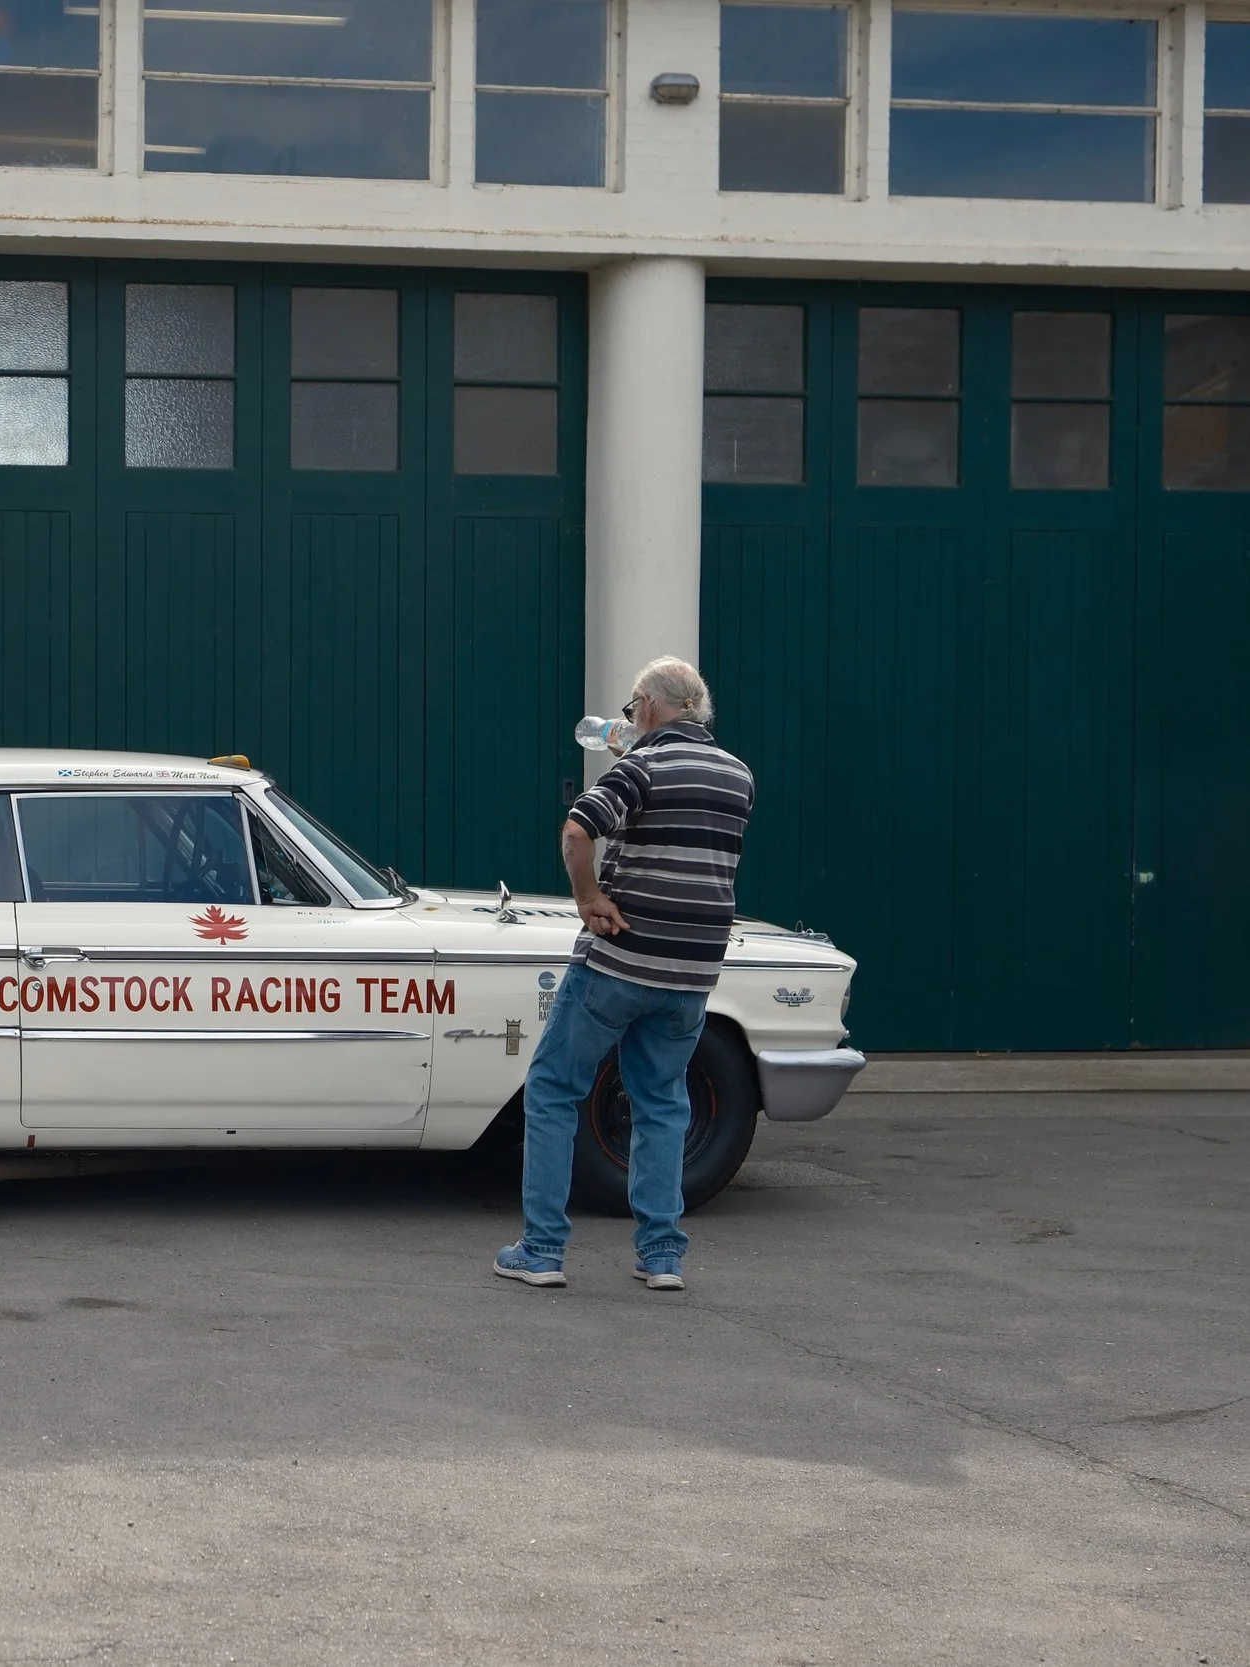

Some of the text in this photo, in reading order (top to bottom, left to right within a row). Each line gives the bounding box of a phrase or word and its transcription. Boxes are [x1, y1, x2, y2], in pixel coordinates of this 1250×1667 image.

[73, 768, 221, 781] Stephen Edwards Matt Neal
[211, 976, 342, 1014] RACING
[355, 978, 456, 1015] TEAM
